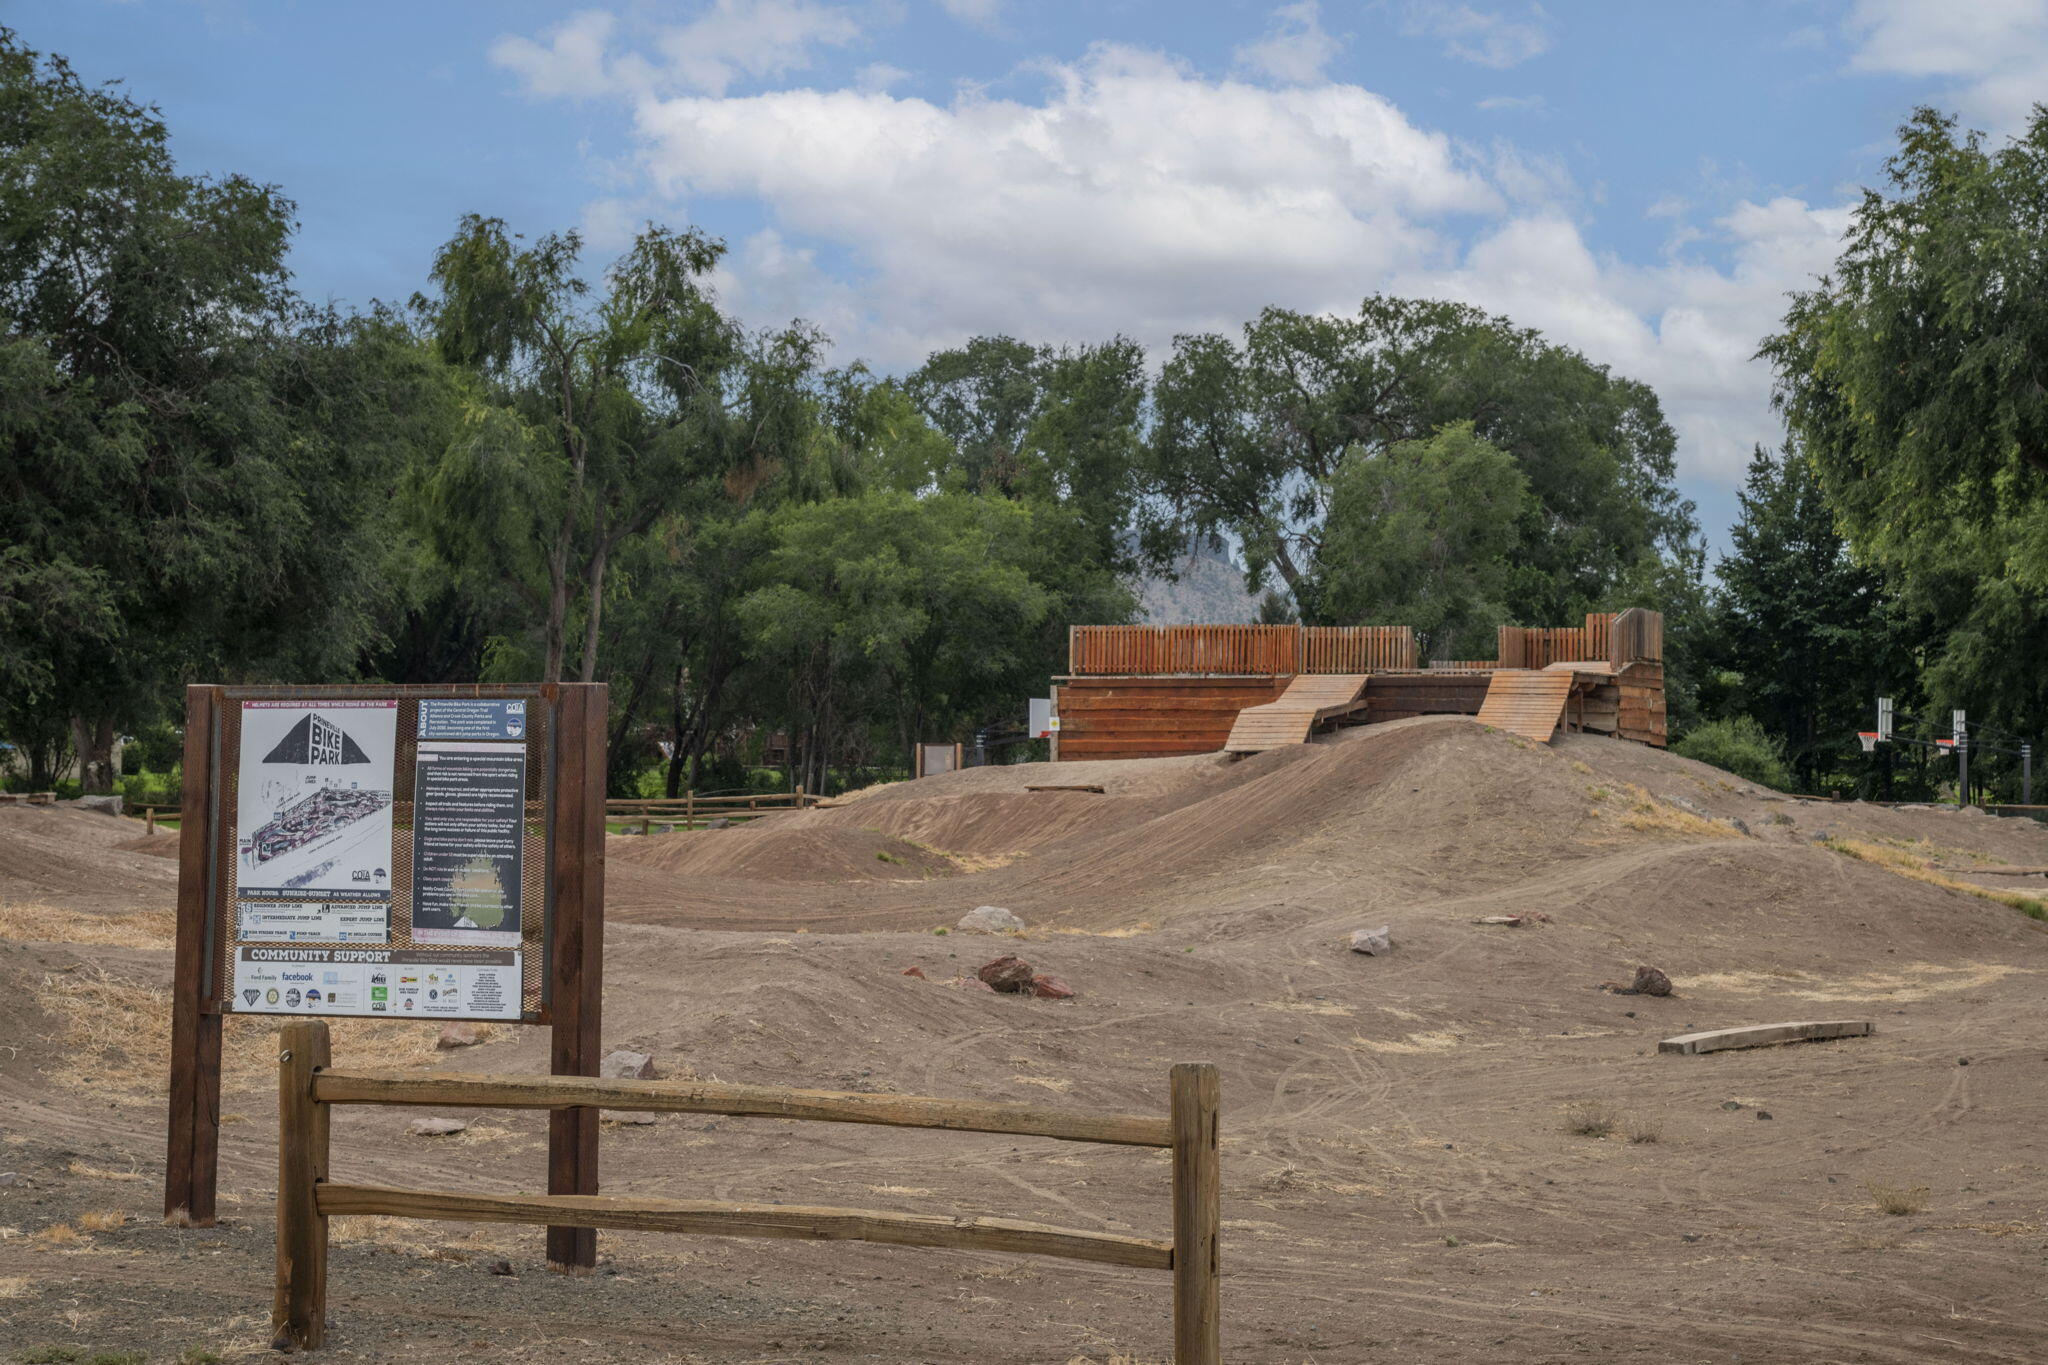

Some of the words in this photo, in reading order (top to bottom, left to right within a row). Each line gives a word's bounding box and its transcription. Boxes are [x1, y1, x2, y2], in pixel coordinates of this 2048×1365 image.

[313, 713, 341, 734] PRINEVILLE
[419, 702, 428, 737] ABOUT
[312, 722, 340, 750] BIKE
[311, 746, 341, 765] PARK
[251, 949, 330, 961] COMMUNITY
[334, 951, 391, 963] SUPPORT
[282, 972, 313, 981] facebook
